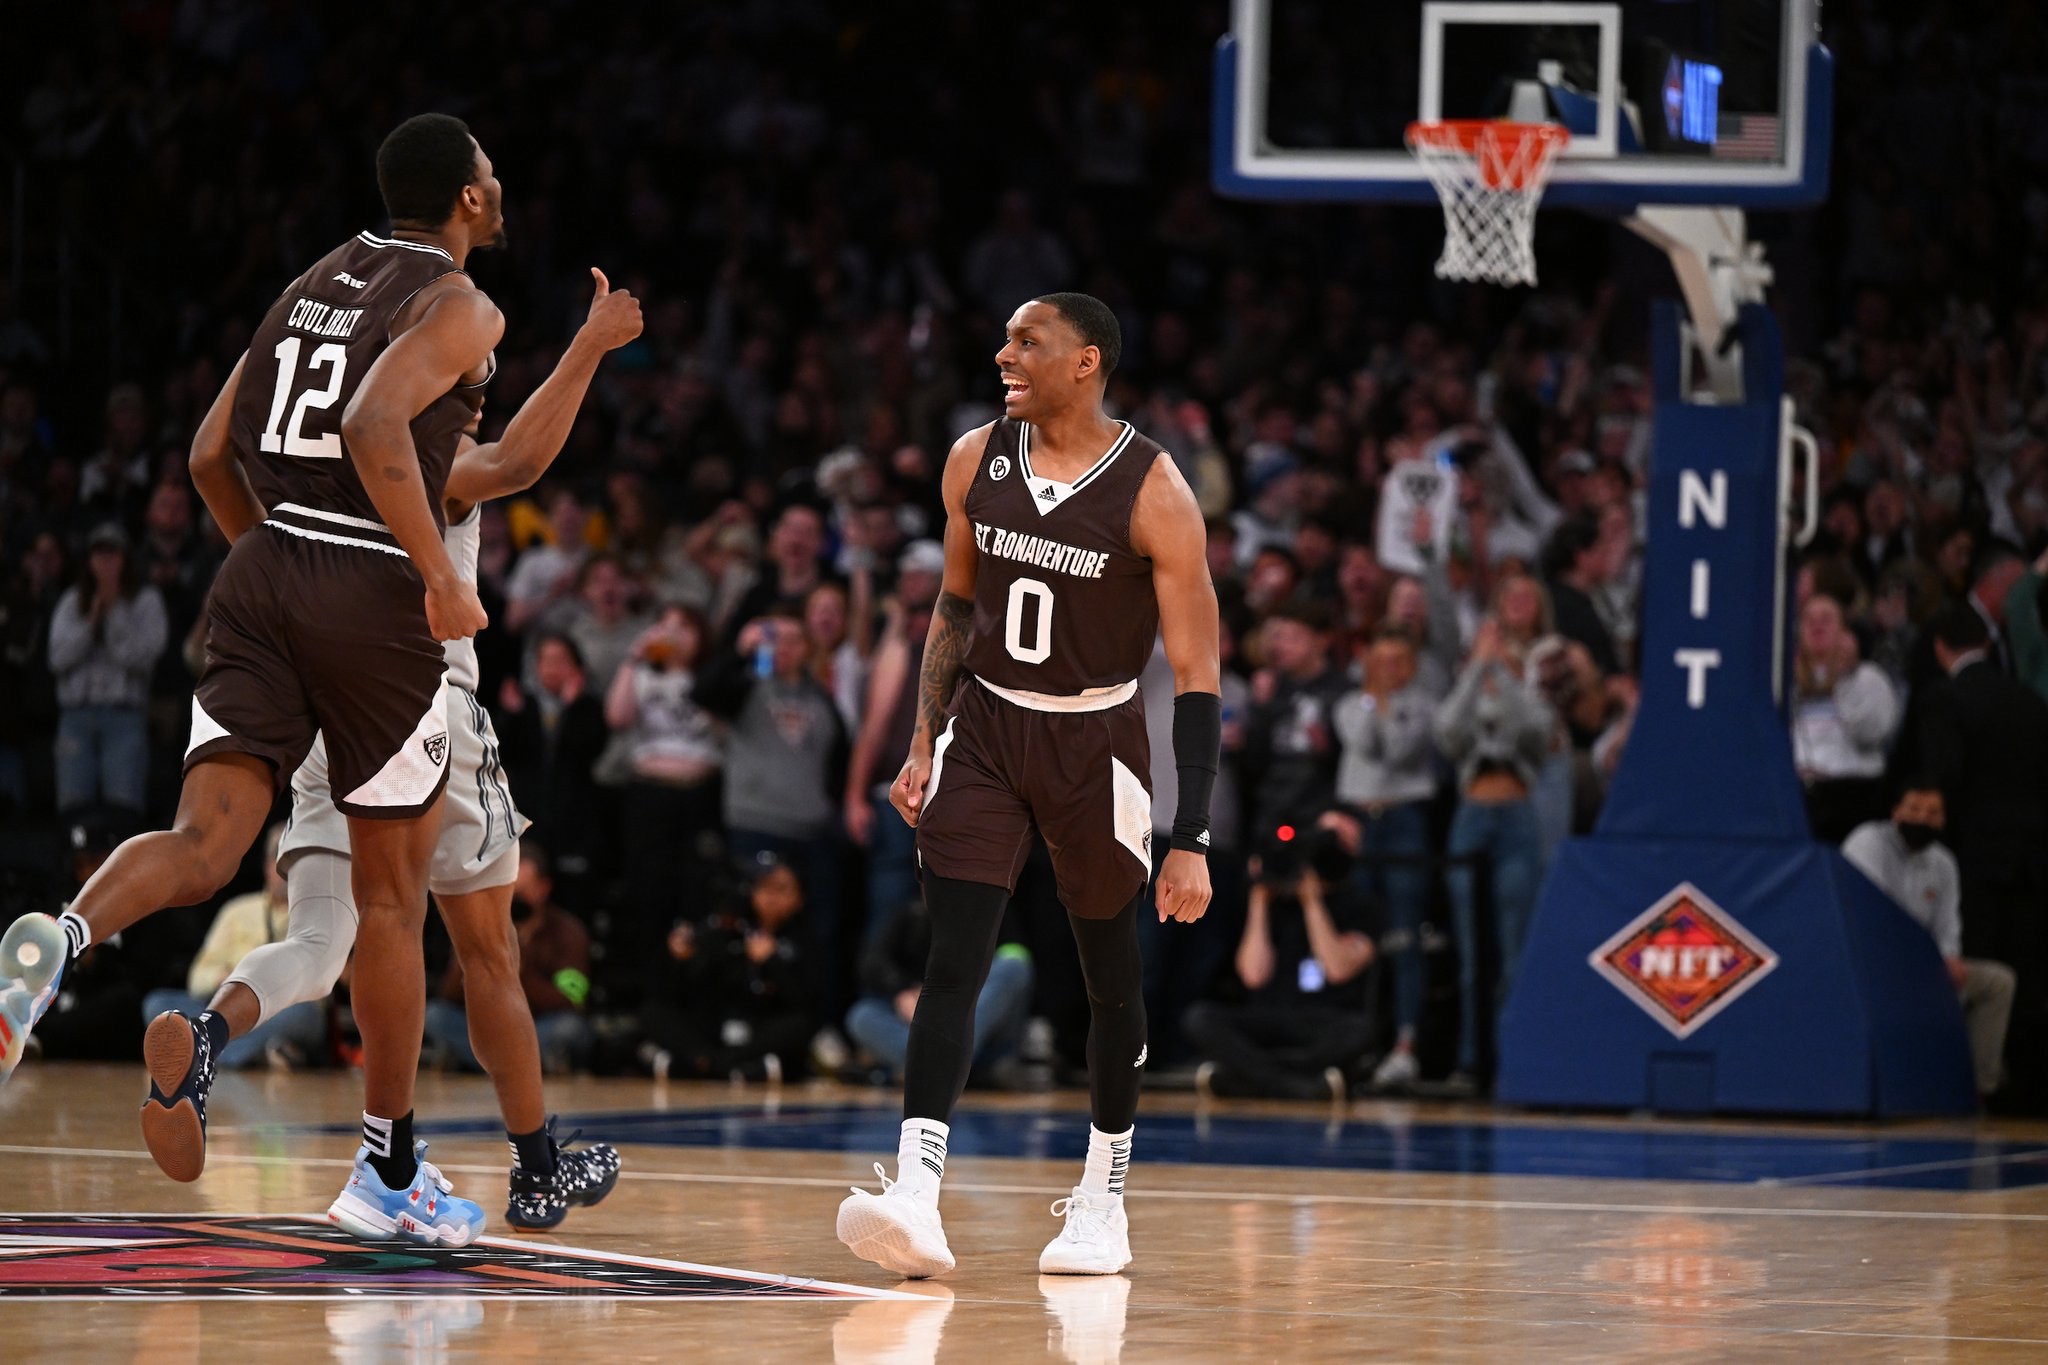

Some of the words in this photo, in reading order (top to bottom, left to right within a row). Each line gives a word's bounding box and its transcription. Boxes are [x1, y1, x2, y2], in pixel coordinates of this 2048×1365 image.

[287, 298, 364, 337] COULIBALY
[260, 336, 347, 459] 12
[1037, 493, 1057, 502] adidas
[974, 521, 991, 555] ST.
[992, 527, 1110, 579] BONAVENTURE
[1005, 577, 1054, 664] 0
[1640, 944, 1735, 980] NIT
